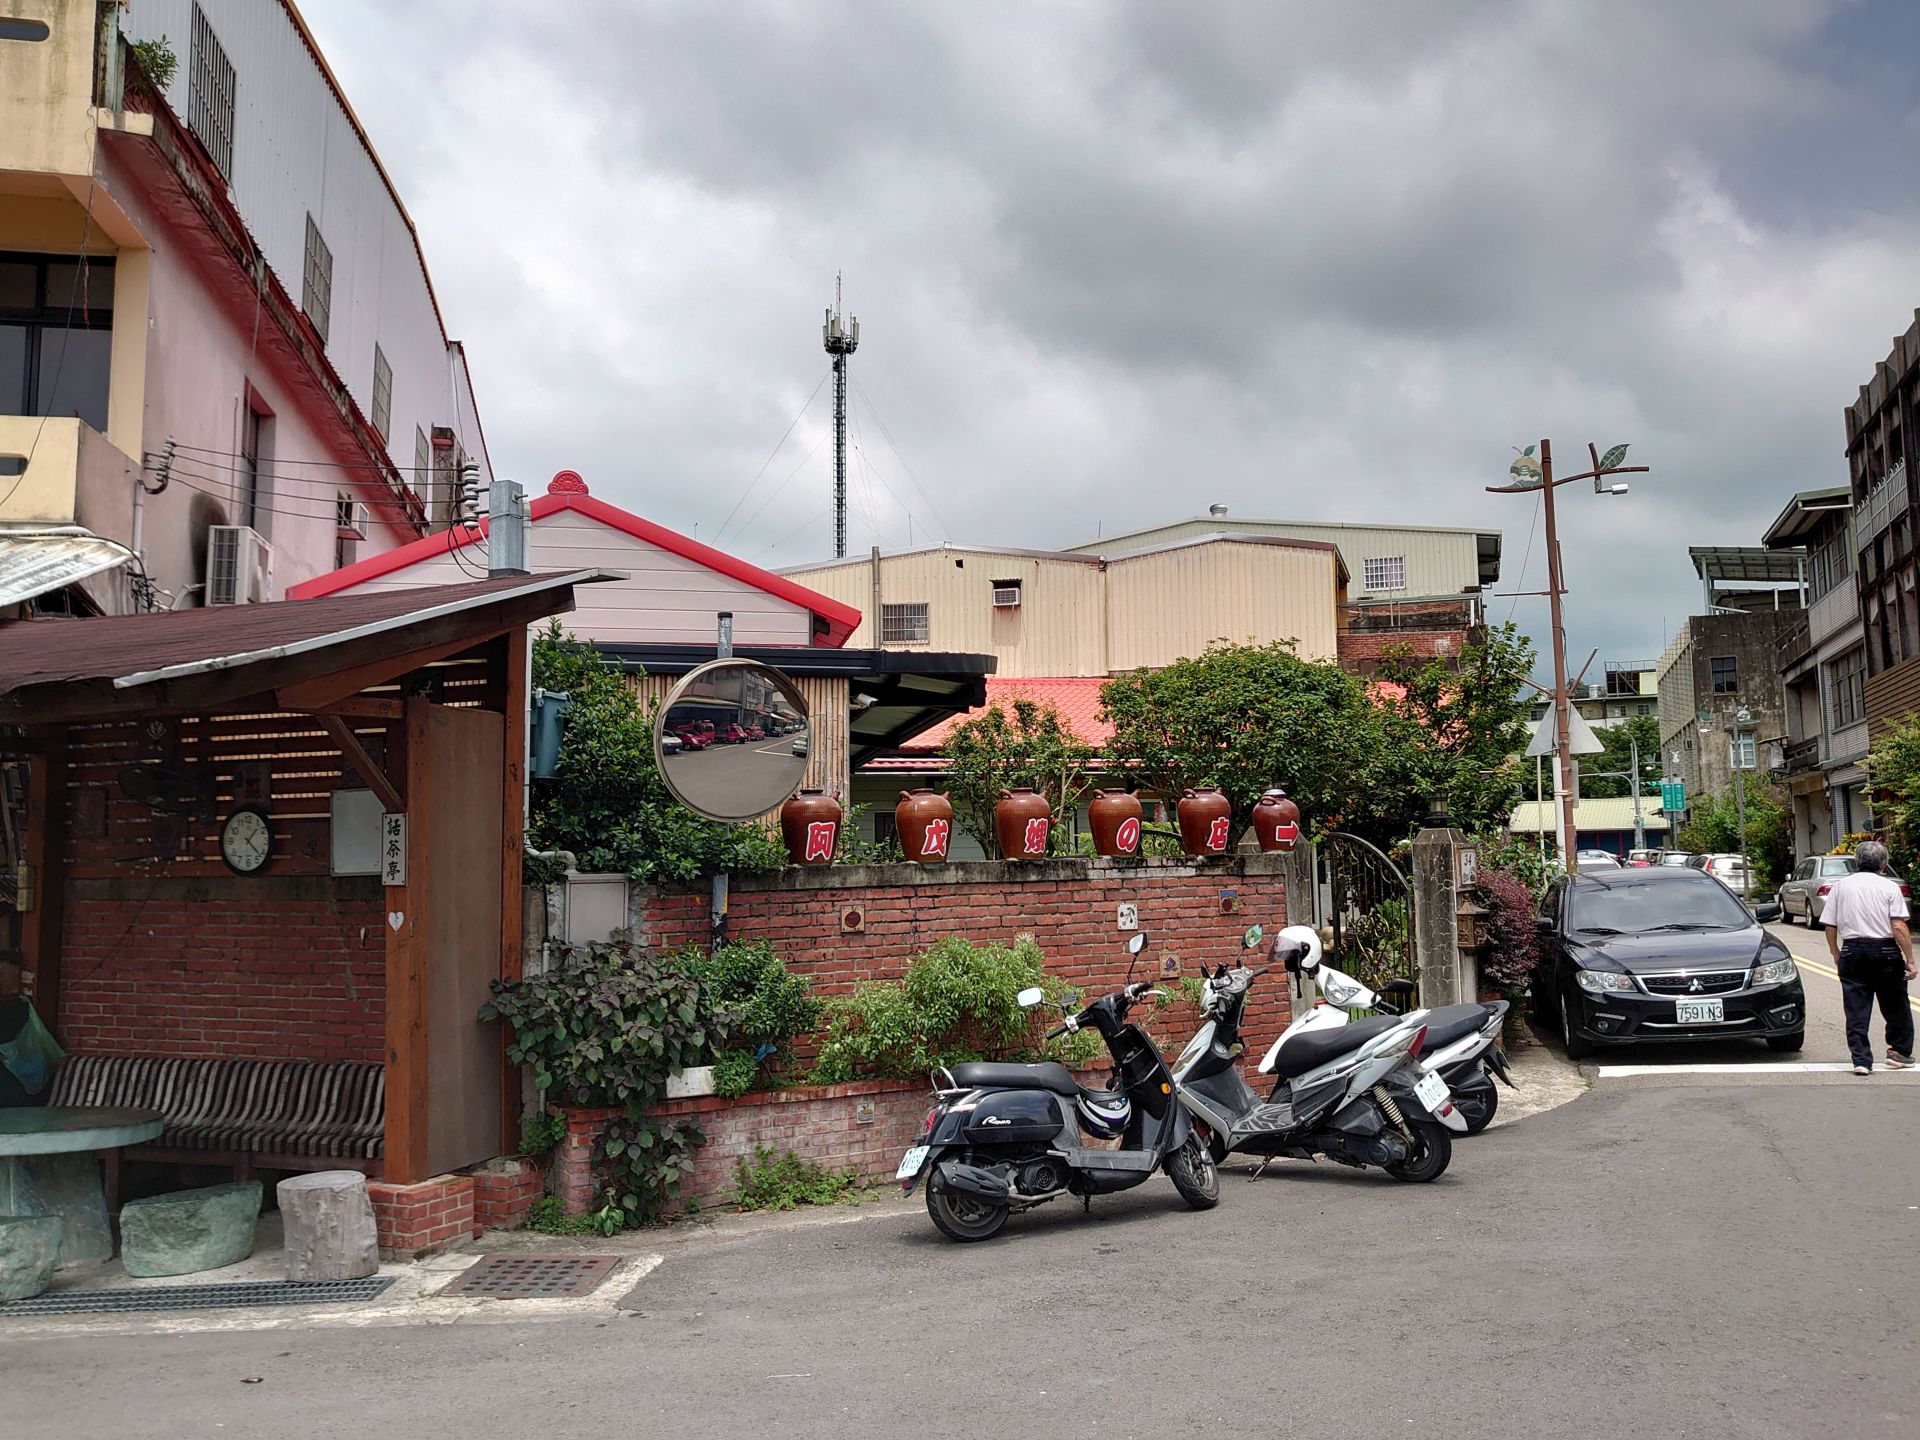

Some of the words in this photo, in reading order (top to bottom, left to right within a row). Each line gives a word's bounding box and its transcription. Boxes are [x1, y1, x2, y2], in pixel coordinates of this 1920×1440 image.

[244, 815, 252, 824] 12
[386, 817, 401, 881] 話茶亭
[805, 821, 836, 861] 阿
[921, 818, 949, 857] 戊
[1116, 817, 1140, 853] の
[1206, 816, 1230, 851] 店
[1677, 1005, 1723, 1020] 7591-N3
